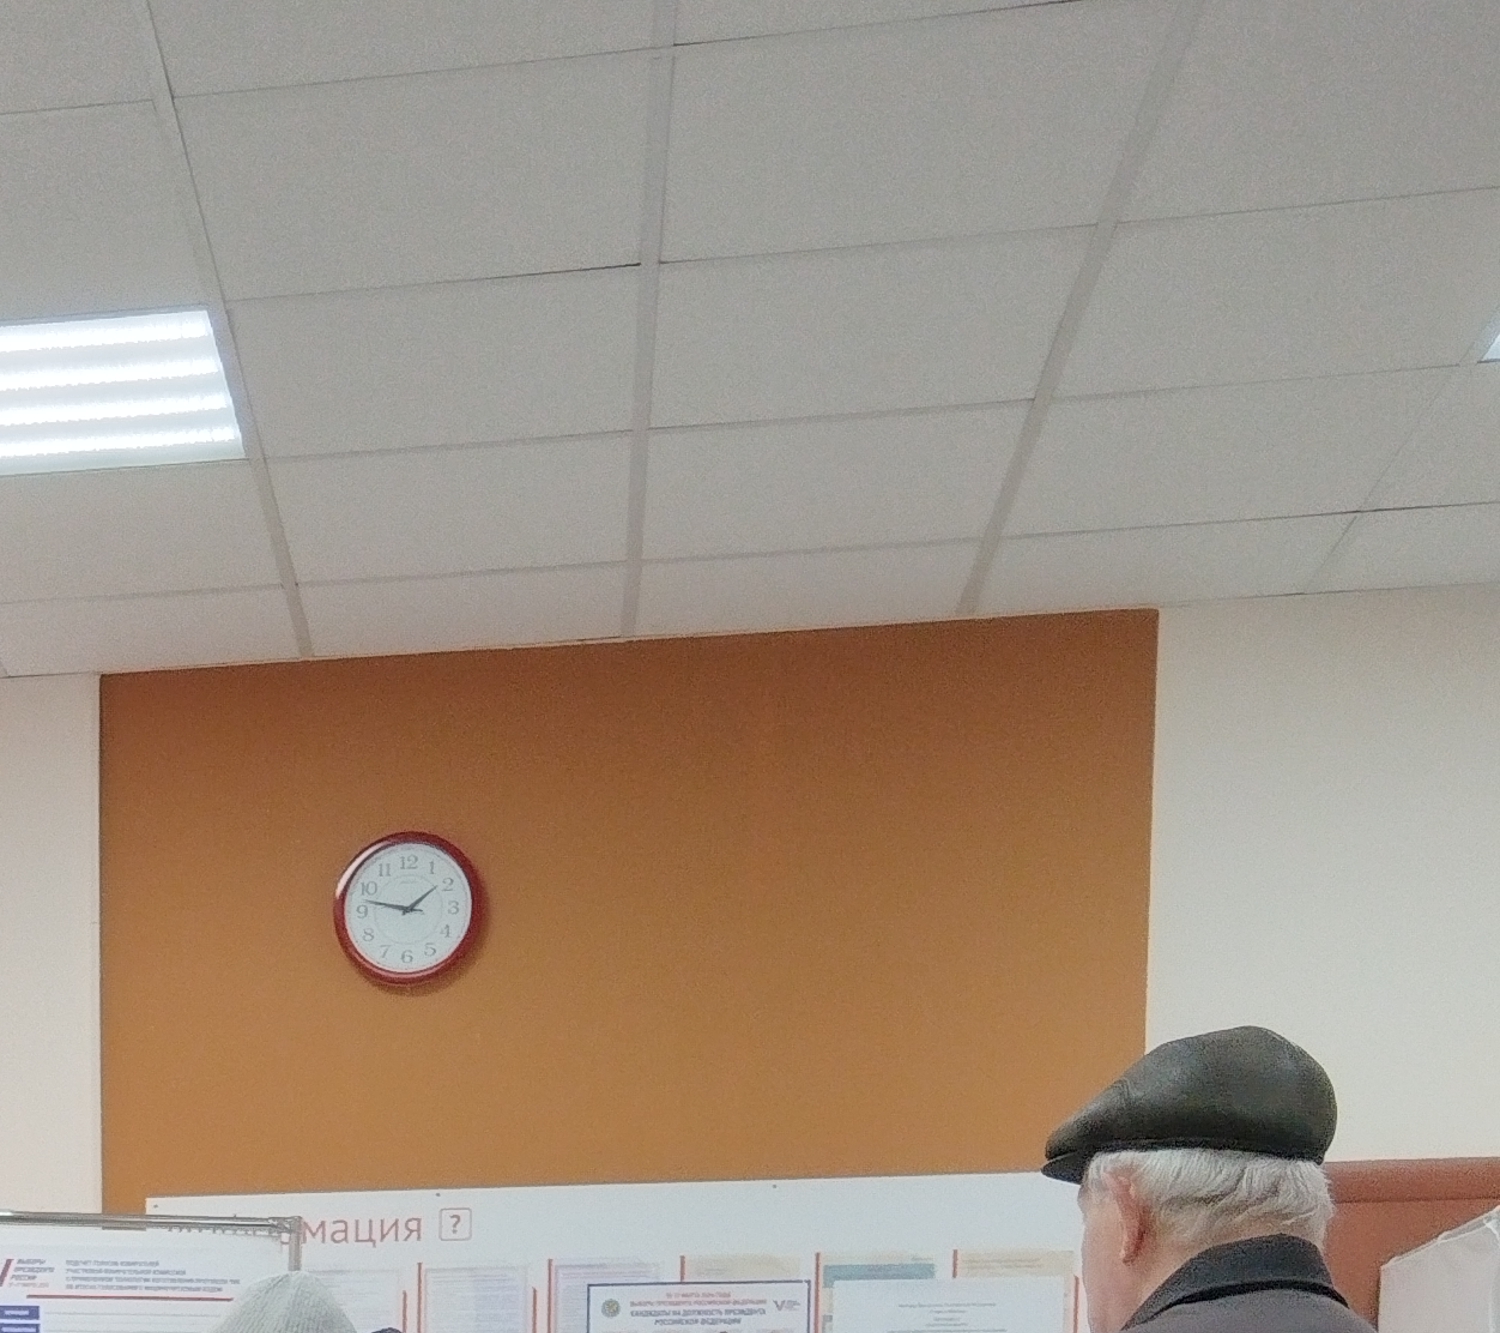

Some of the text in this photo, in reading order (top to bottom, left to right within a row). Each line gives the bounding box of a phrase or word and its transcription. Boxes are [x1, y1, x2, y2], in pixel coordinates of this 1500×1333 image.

[378, 862, 391, 877] 11
[400, 854, 418, 870] 12
[429, 860, 435, 875] 1
[360, 881, 378, 895] 10
[441, 877, 454, 891] 2
[356, 904, 369, 919] 9
[447, 900, 460, 915] 3
[362, 927, 375, 942] 8
[440, 923, 451, 938] 4
[379, 944, 391, 959] 7
[401, 949, 414, 964] 6
[424, 942, 437, 957] 5
[281, 1216, 423, 1249] мация
